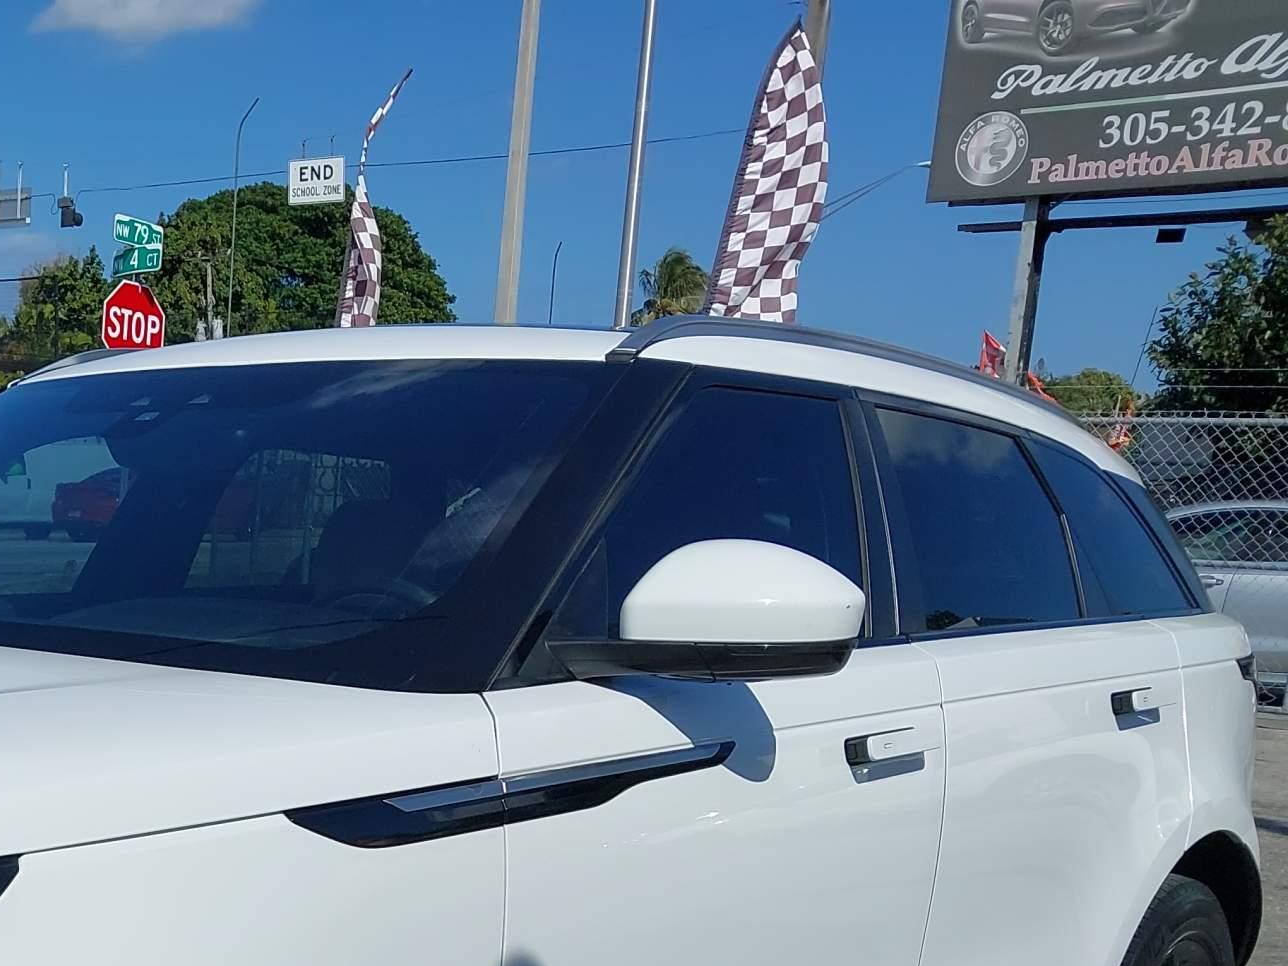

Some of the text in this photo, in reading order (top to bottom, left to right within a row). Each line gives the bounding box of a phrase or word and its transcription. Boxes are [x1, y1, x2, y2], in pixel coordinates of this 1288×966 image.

[990, 51, 1219, 101] Palmetto
[960, 115, 1025, 152] ALFA ROMEO
[299, 164, 334, 182] END
[1027, 137, 1288, 184] PalmettoAlfaRo
[291, 184, 342, 198] SCHOOL ZONE
[116, 222, 161, 245] NW 79 ST
[129, 249, 139, 269] 4
[146, 253, 159, 267] CT
[107, 306, 161, 347] STOP
